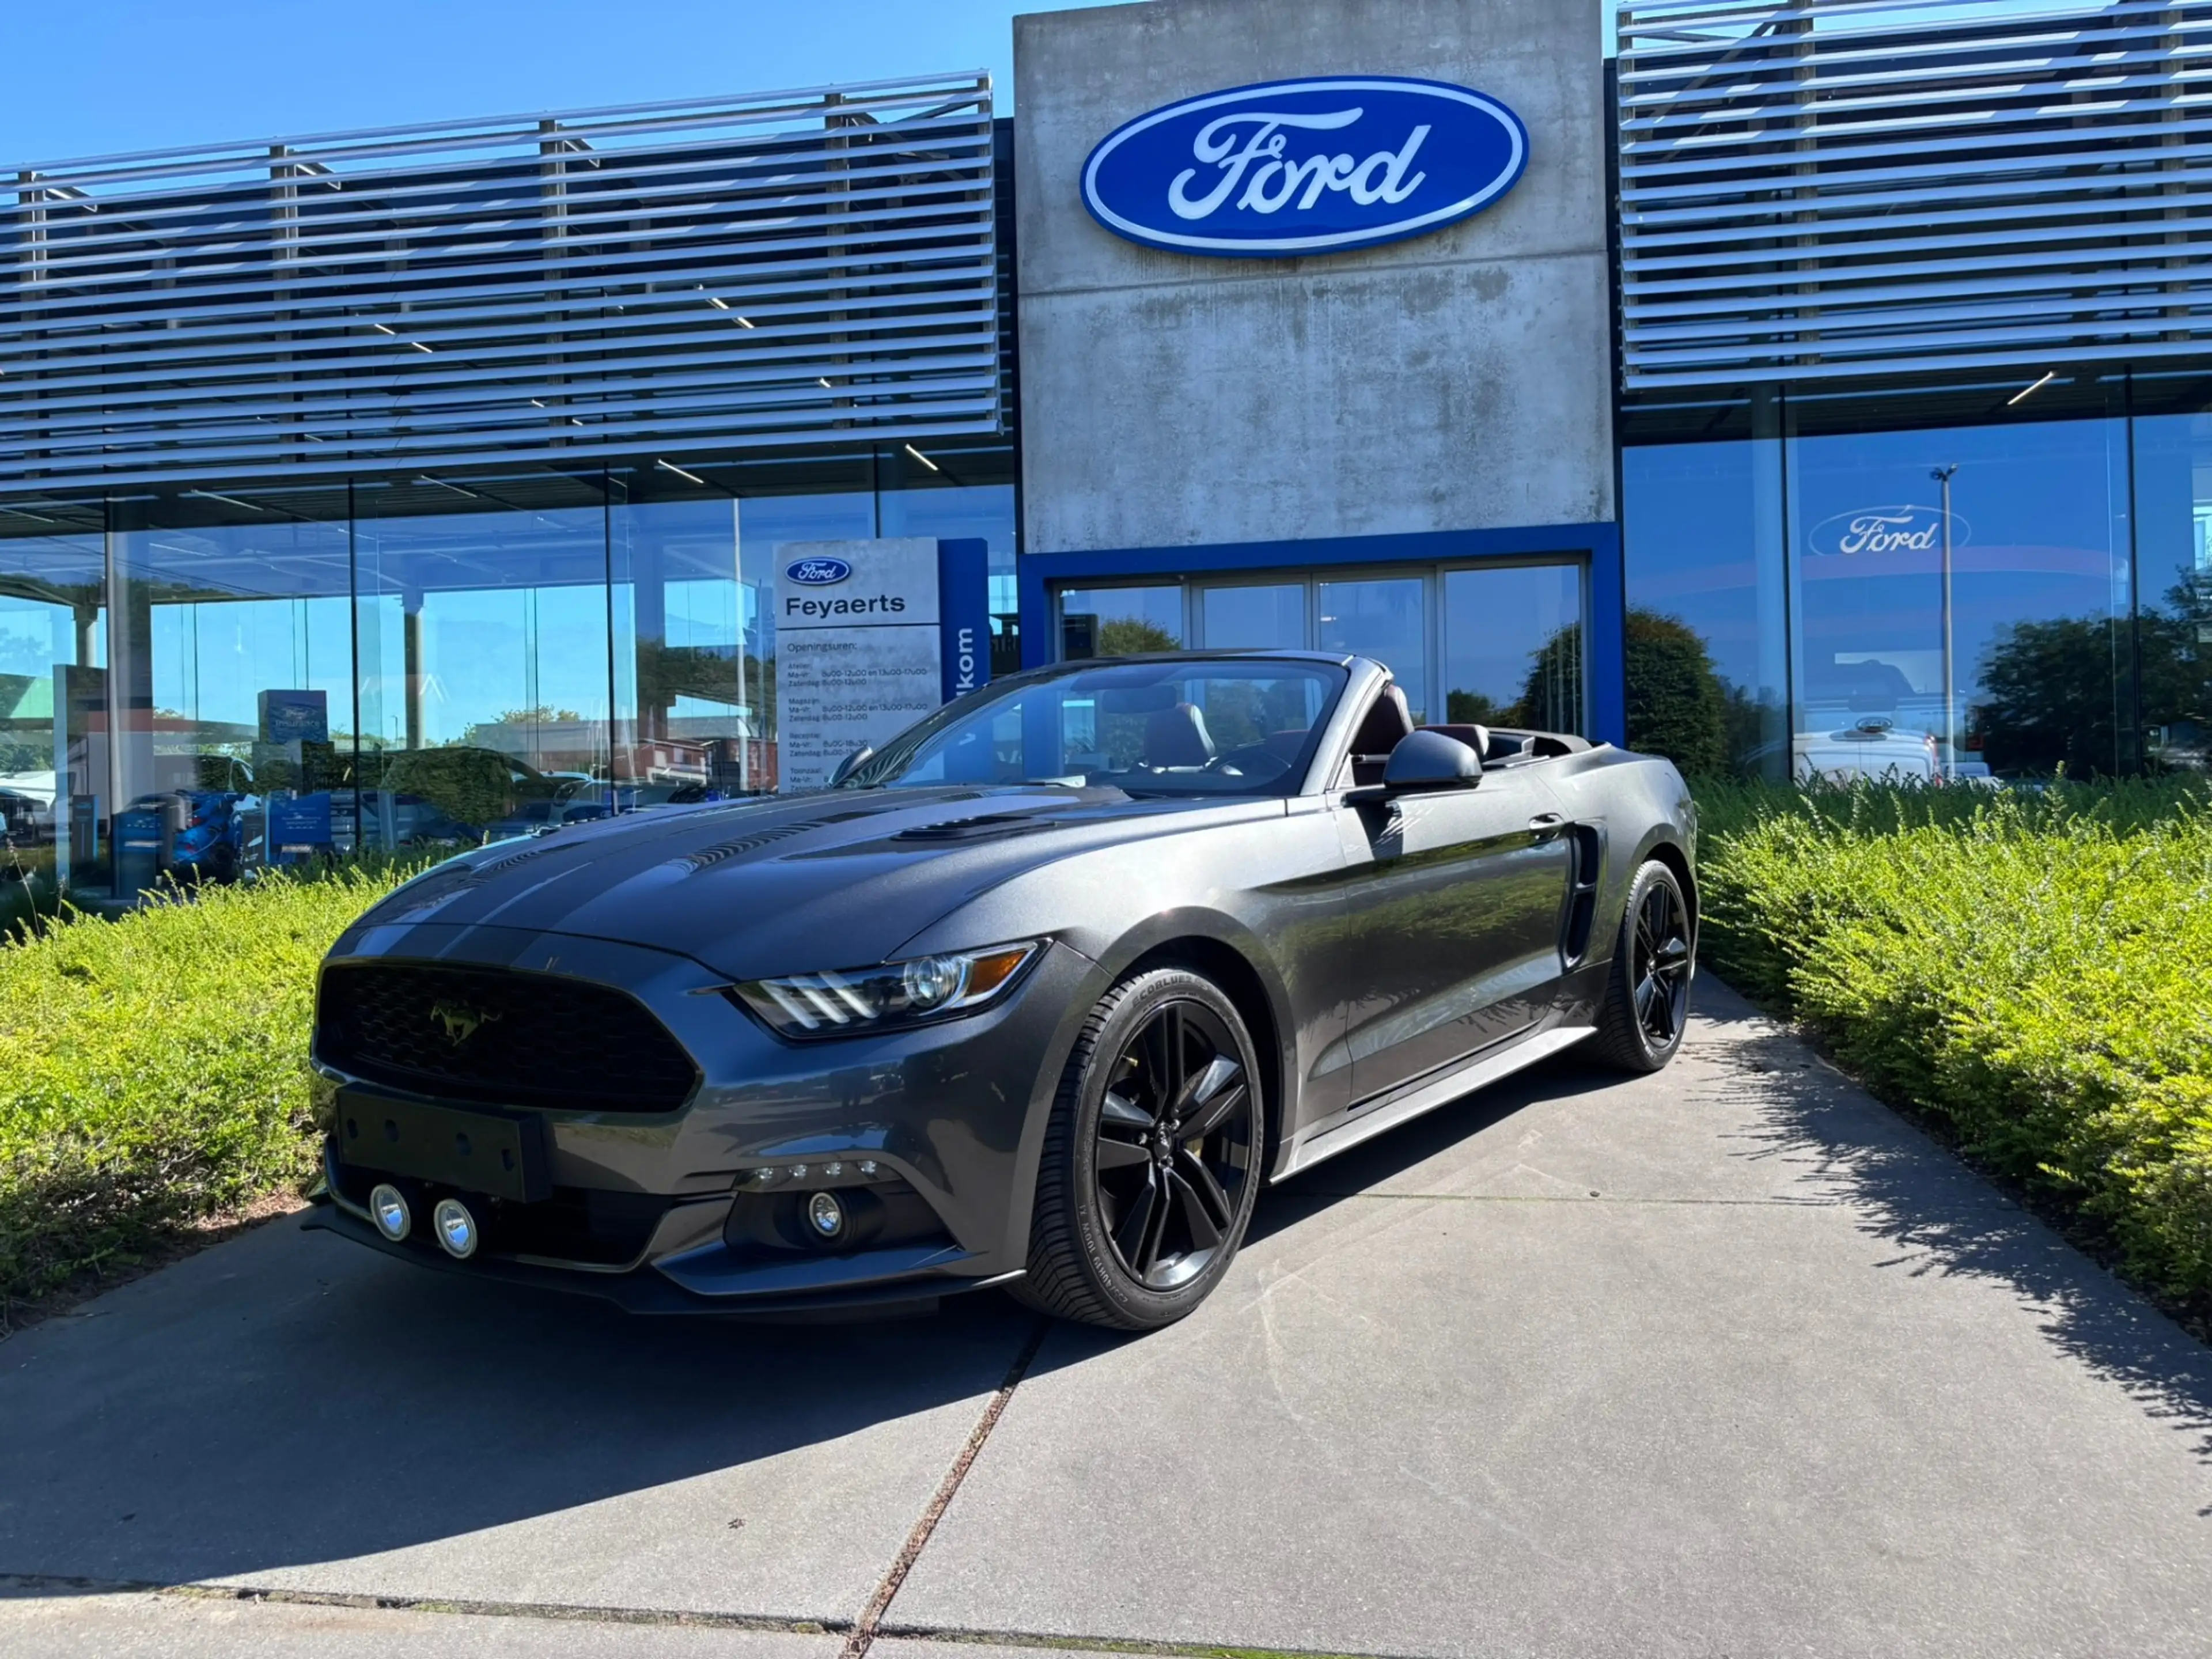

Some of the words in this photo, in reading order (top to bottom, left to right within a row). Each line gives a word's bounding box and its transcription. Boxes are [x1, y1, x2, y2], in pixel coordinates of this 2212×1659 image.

[1168, 107, 1432, 220] Ford
[1839, 515, 1938, 554] Ford
[797, 562, 838, 579] Ford
[786, 594, 906, 619] Feyaerts
[787, 642, 857, 653] Openingsuren:
